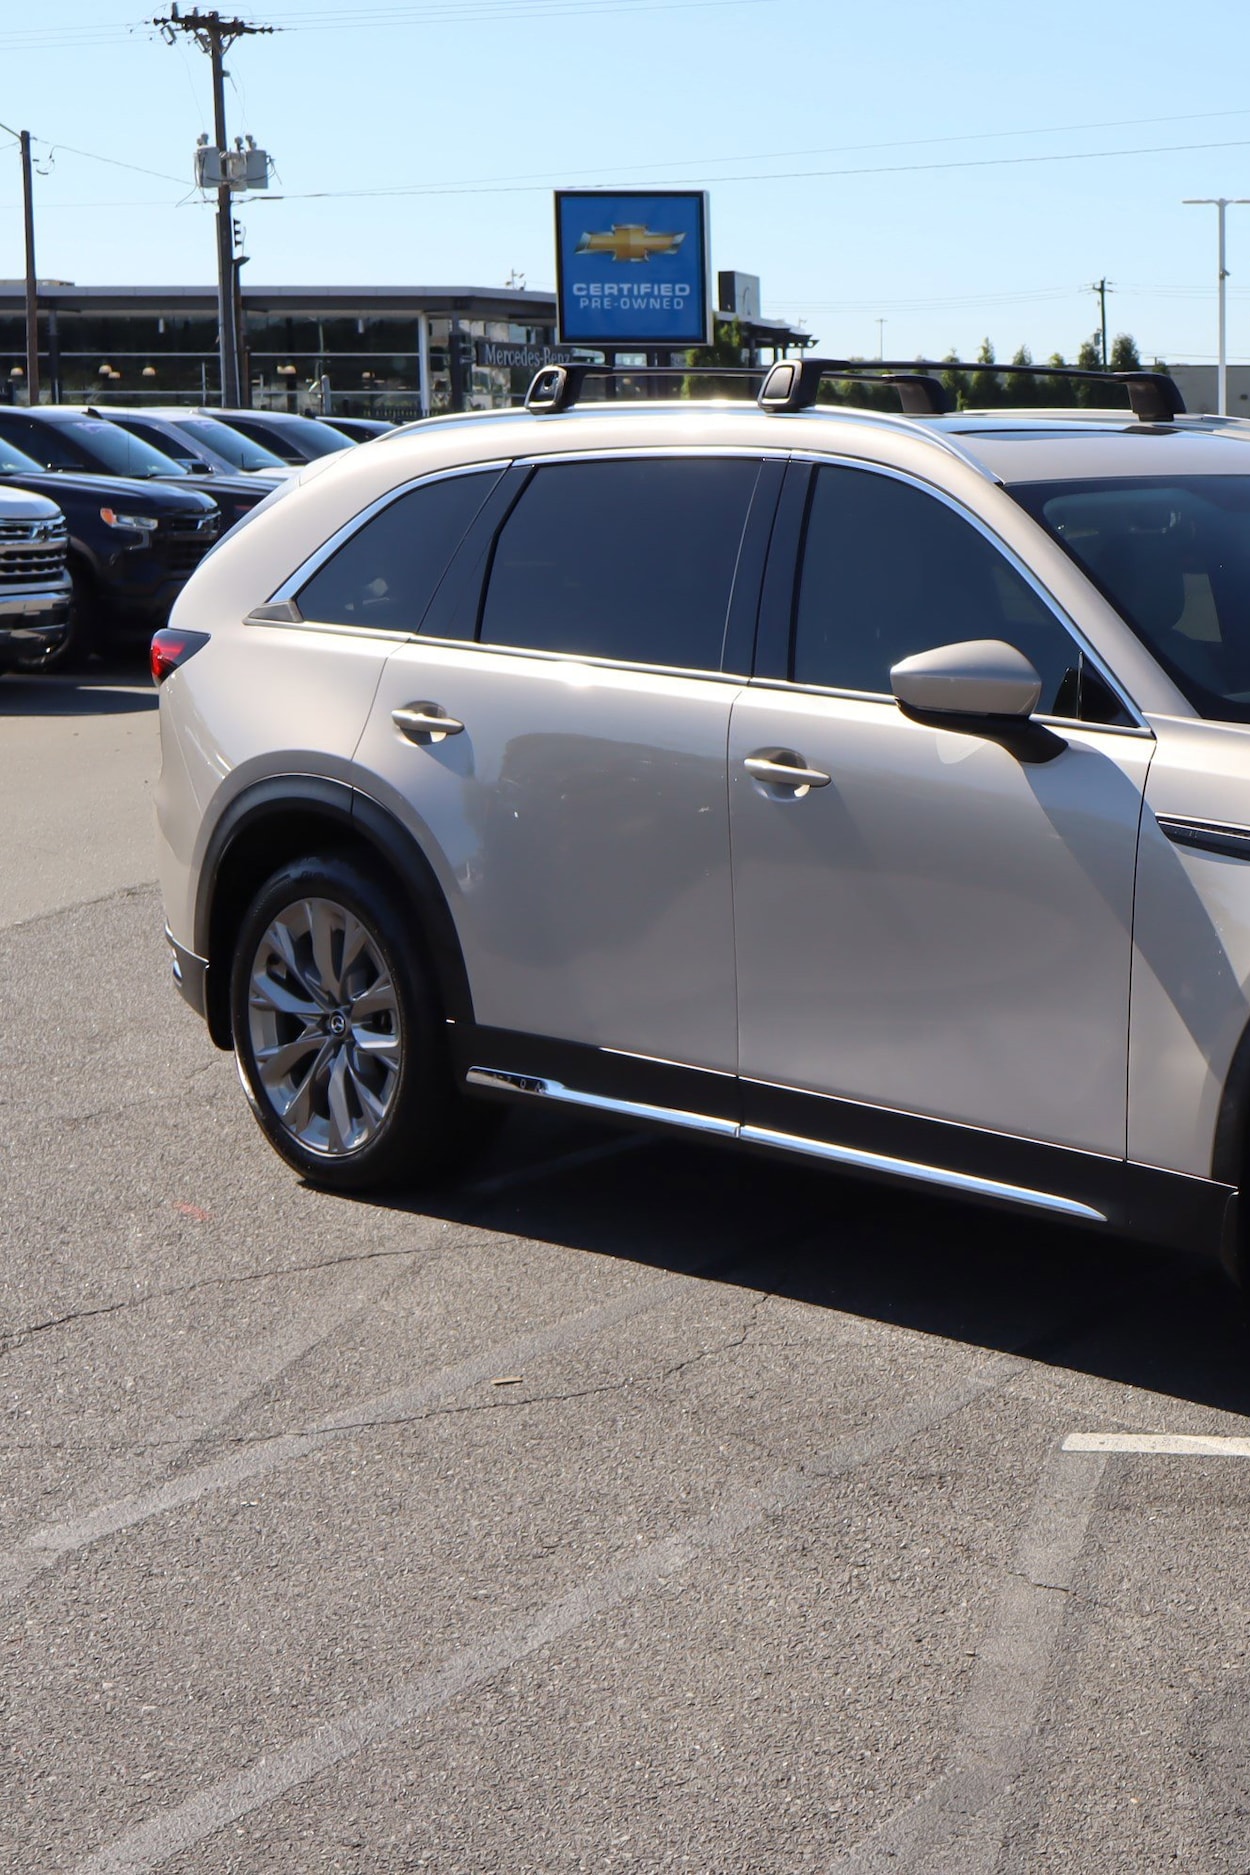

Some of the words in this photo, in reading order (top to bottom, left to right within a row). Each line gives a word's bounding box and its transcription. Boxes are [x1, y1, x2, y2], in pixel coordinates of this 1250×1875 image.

[572, 283, 690, 296] CERTIFIED
[579, 298, 684, 309] PRE-OWNED
[485, 344, 570, 366] Mercedes-Benz
